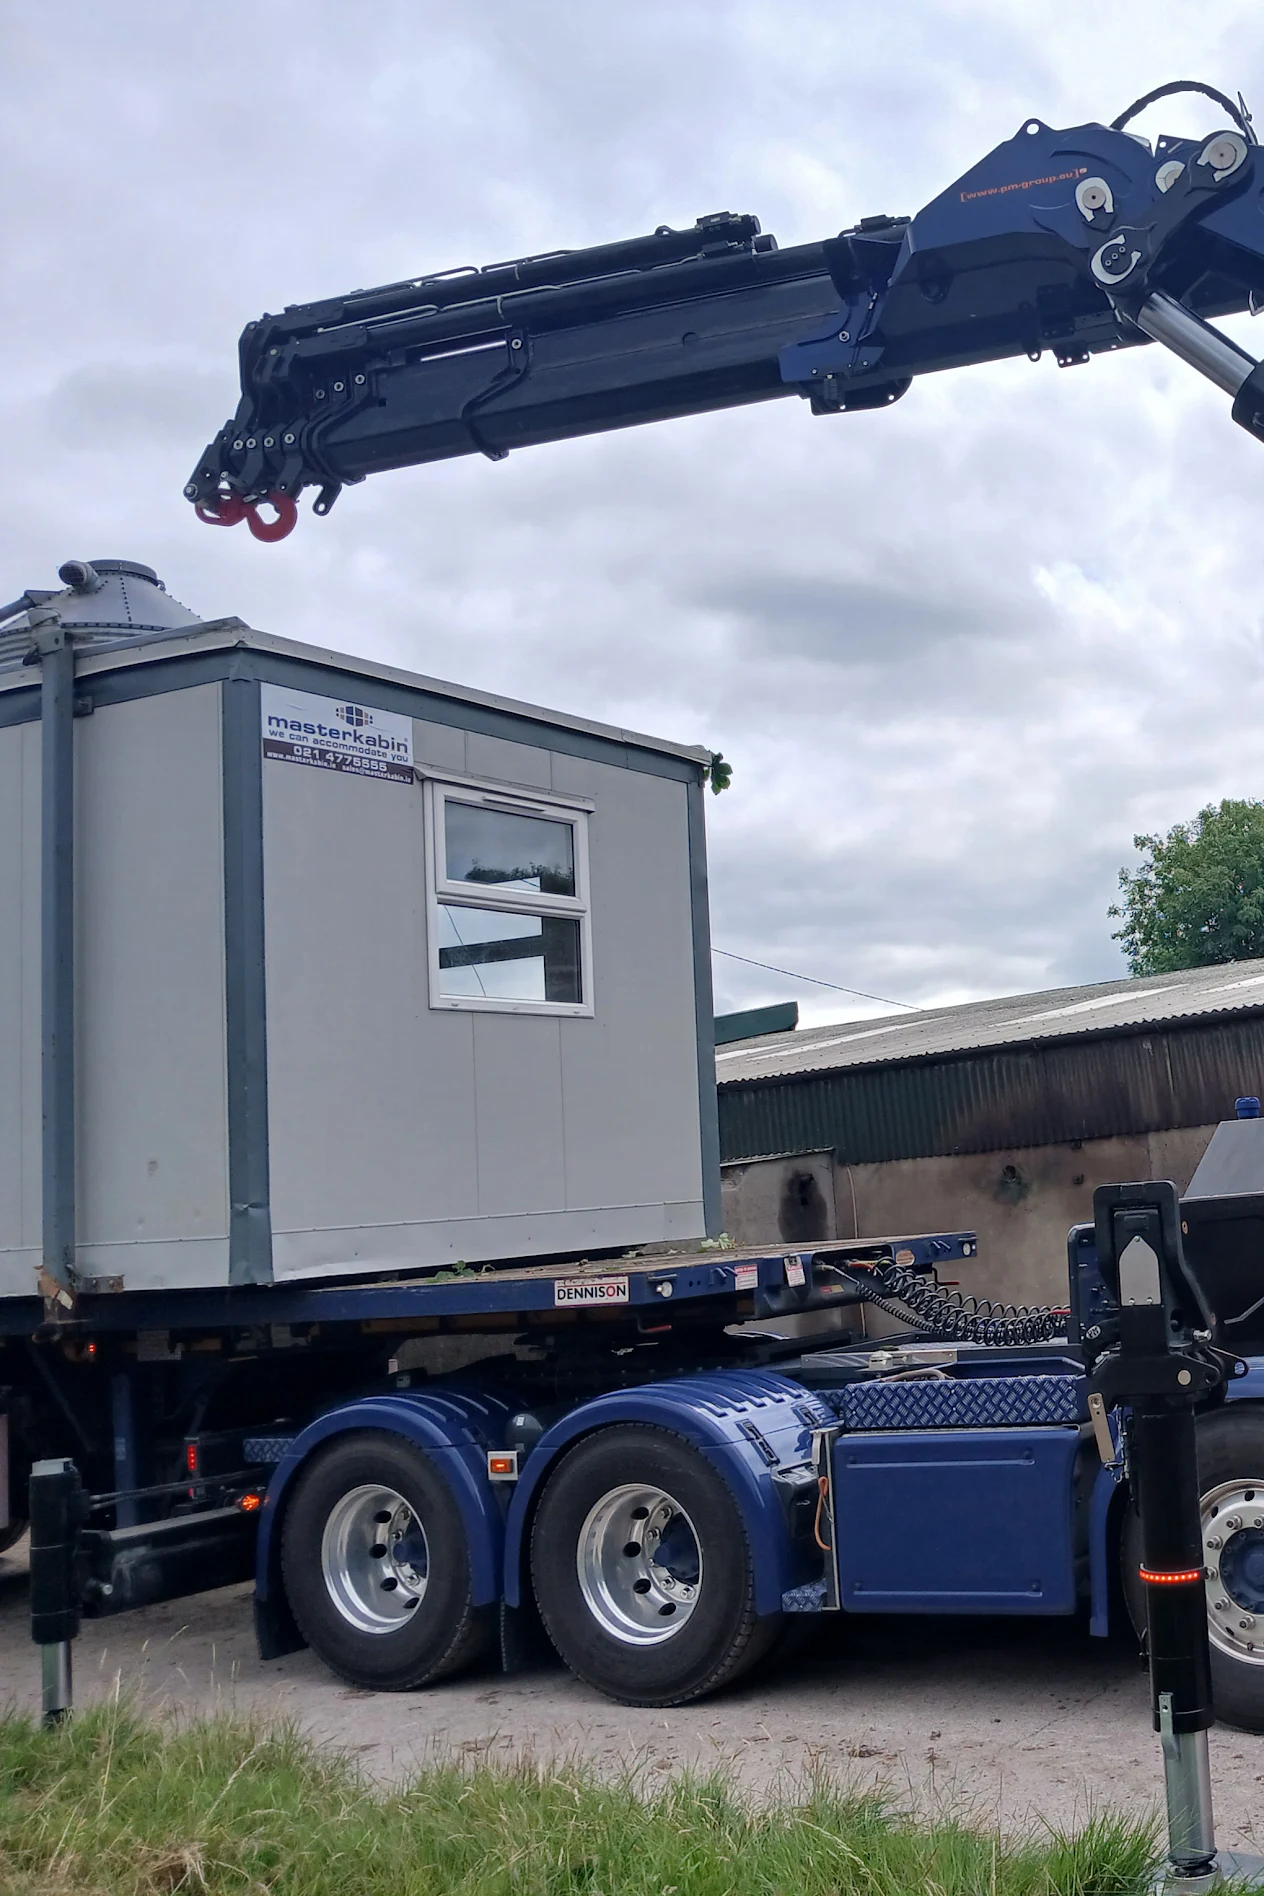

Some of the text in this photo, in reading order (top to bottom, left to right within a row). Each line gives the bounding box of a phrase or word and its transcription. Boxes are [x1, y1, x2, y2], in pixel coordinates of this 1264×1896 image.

[268, 728, 409, 763] we can accommodate you
[293, 745, 388, 772] 021 4775555
[557, 1284, 626, 1301] DENNISON
